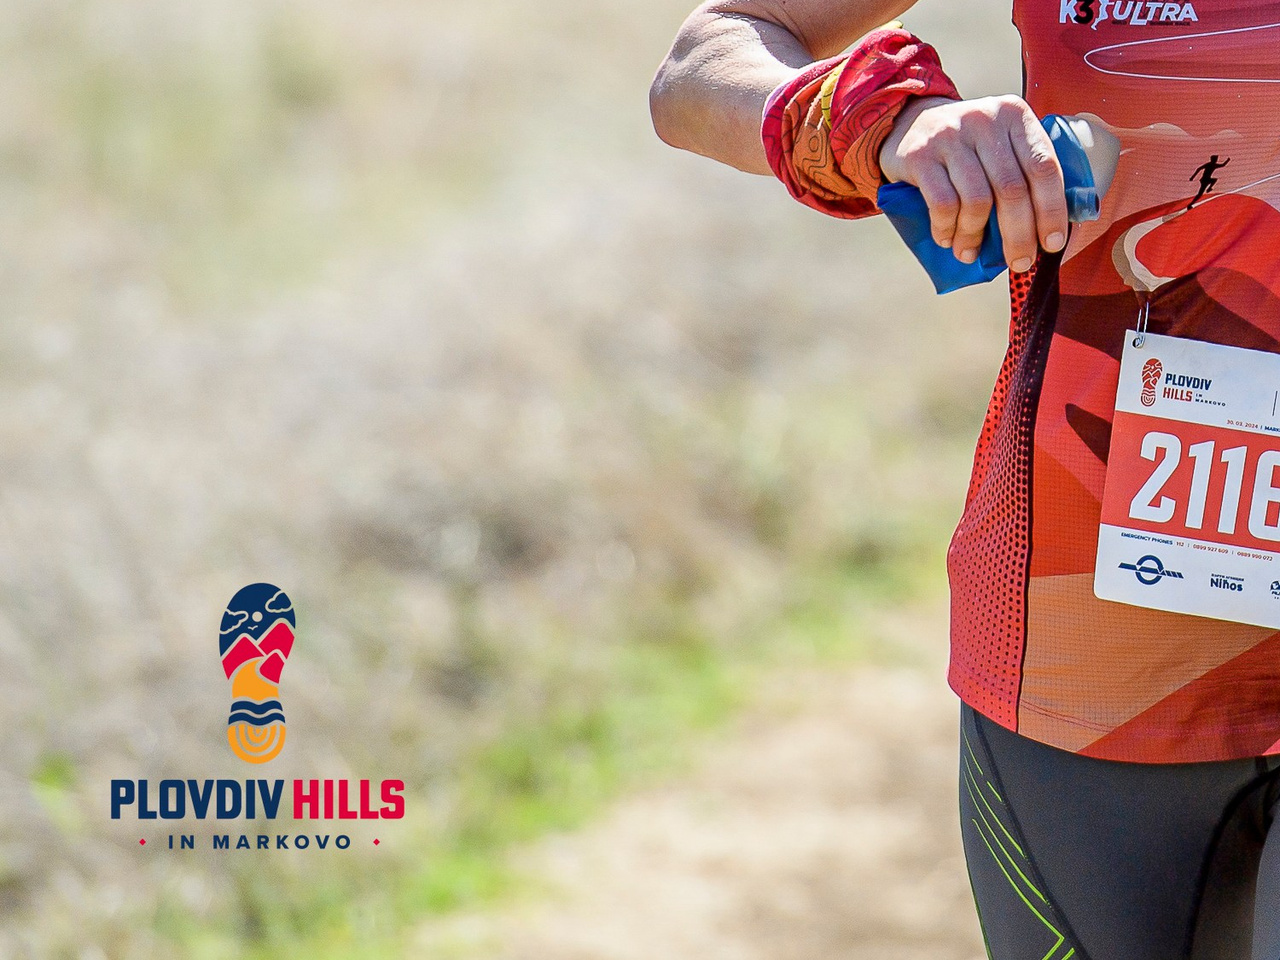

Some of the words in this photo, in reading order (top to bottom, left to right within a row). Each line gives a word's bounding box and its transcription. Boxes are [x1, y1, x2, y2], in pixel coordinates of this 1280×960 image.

[1112, 0, 1199, 26] ULTRA
[1165, 373, 1212, 390] PLOVDIV
[1163, 387, 1193, 402] HILLS
[1195, 398, 1226, 407] MARKOVO
[1121, 532, 1151, 541] EMERGENCY
[1151, 537, 1173, 545] PHONES
